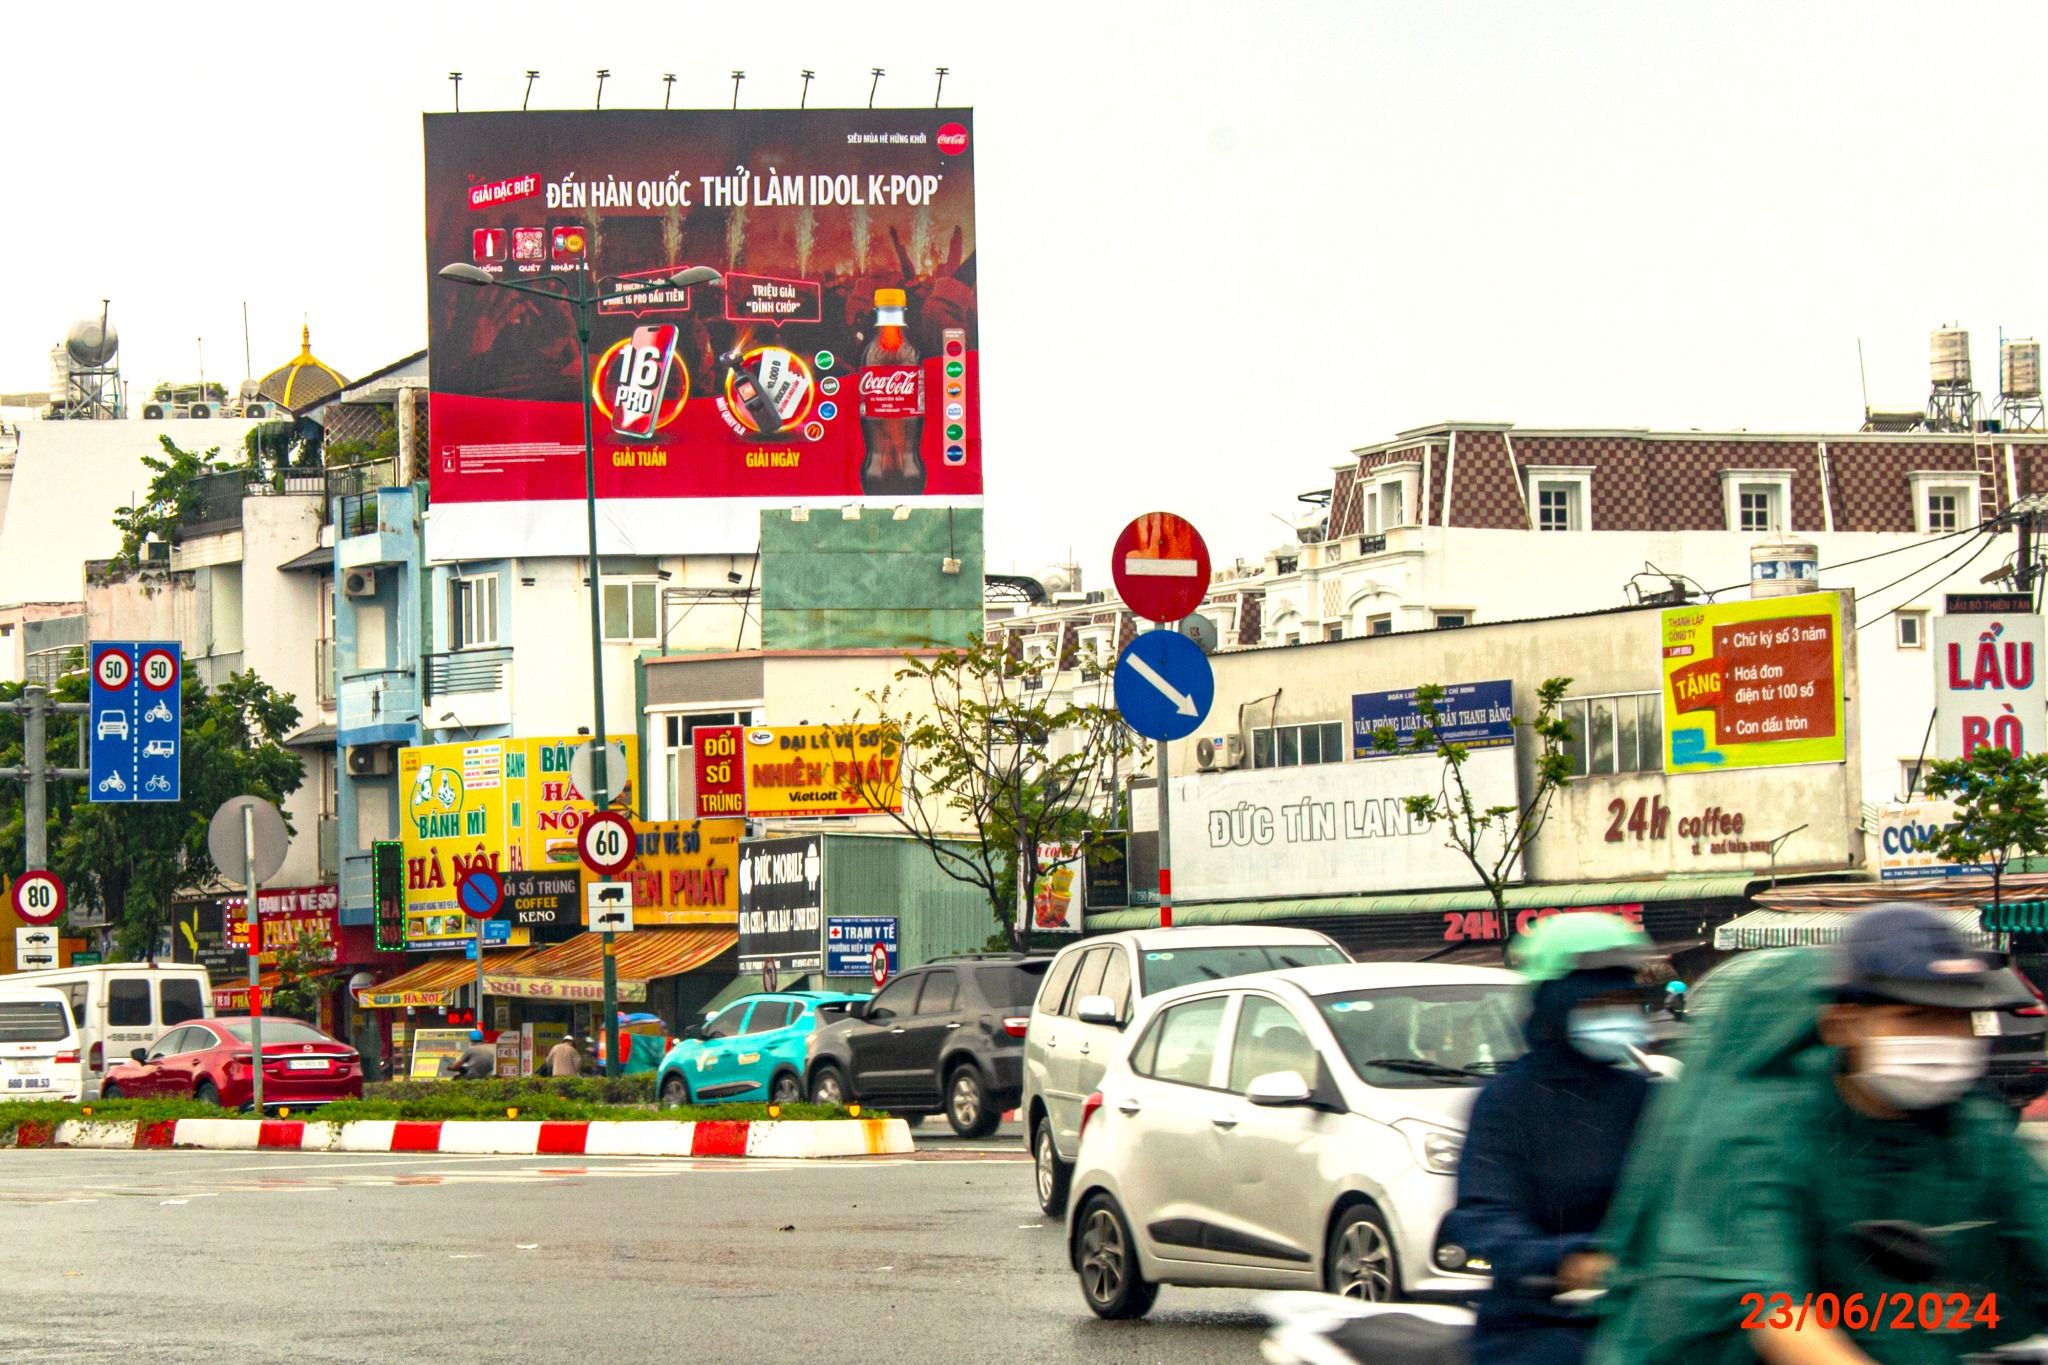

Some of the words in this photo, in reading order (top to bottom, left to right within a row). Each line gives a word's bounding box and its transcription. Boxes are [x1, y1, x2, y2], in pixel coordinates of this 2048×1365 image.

[472, 183, 493, 204] GIẢI
[493, 180, 513, 202] ĐẶC
[513, 175, 536, 197] BIỆT
[546, 172, 586, 209] ĐẾN
[591, 174, 633, 208] HÀN
[637, 171, 692, 209] QUỐC
[700, 165, 751, 207] THỬ
[753, 166, 804, 207] LÀM
[809, 175, 865, 207] IDOL
[551, 263, 575, 274] NHẬP
[752, 283, 778, 299] TRIỆU
[779, 284, 796, 298] GIẢI
[617, 344, 662, 392] 16
[614, 385, 654, 415] PRO
[613, 447, 636, 467] GIẢI
[746, 448, 769, 468] GIẢI
[770, 448, 800, 467] NGÀY
[1668, 616, 1691, 628] THÀNH
[1692, 614, 1705, 627] LẬP
[1668, 629, 1688, 642] CÔNG
[1688, 629, 1696, 639] TY
[1733, 630, 1759, 648] Chữ
[1759, 631, 1773, 649] ký
[1775, 626, 1790, 644] số
[1791, 628, 1800, 643] 3
[1801, 626, 1827, 641] năm
[1947, 621, 2035, 691] LẨU
[106, 660, 122, 680] 50
[151, 660, 167, 680] 50
[1734, 665, 1758, 681] Hoá
[1760, 665, 1783, 679] đơn
[1404, 690, 1418, 700] LUẬ
[1448, 686, 1459, 695] CHÍ
[1459, 686, 1476, 694] MINH
[1676, 671, 1721, 700] TẶNG
[1735, 687, 1760, 705] điện
[1777, 684, 1798, 700] 100
[1800, 680, 1815, 697] số
[1355, 717, 1371, 735] VĂN
[1372, 714, 1399, 733] PHÒNG
[1401, 711, 1422, 734] LUẬT
[1458, 709, 1487, 725] THANH
[1489, 700, 1512, 723] BẰNG
[1736, 719, 1759, 736] Con
[1761, 715, 1783, 733] dấu
[1785, 715, 1808, 730] tròn
[704, 730, 736, 757] ĐỔI
[780, 735, 806, 752] ĐẠI
[811, 731, 829, 749] LÝ
[859, 728, 880, 747] SỐ
[1962, 703, 2024, 763] BÒ
[541, 741, 579, 773] BÁN
[706, 758, 731, 784] SỐ
[753, 756, 822, 787] NHIÊN
[833, 753, 894, 785] PHÁT
[700, 789, 742, 812] TRÚNG
[418, 811, 460, 839] BÁNH
[466, 805, 487, 837] MÌ
[1209, 801, 1273, 848] ĐỨC
[1281, 796, 1337, 844] TÍN
[1344, 798, 1433, 840] LAND
[1604, 794, 1671, 843] 24h
[1678, 806, 1745, 839] coffee
[595, 830, 619, 856] 60
[645, 825, 660, 855] LÝ
[663, 824, 680, 855] VÉ
[682, 820, 701, 854] SỐ
[408, 847, 446, 890] HÀ
[754, 843, 772, 886] ĐỨC
[773, 851, 804, 883] MOBILE
[503, 876, 518, 897] ỔI
[519, 875, 534, 897] SỐ
[536, 874, 576, 895] TRÚNG
[670, 857, 729, 907] PHÁT
[28, 885, 50, 908] 80
[515, 897, 558, 910] COFFEE
[519, 910, 556, 923] KENO
[1443, 910, 1503, 941] 24H
[844, 926, 873, 942] TRẠM
[875, 926, 881, 939] Y
[883, 922, 896, 939] TẾ
[232, 989, 250, 1008] PHÁ
[528, 980, 553, 996] SỐ
[560, 982, 625, 999] TRÚG
